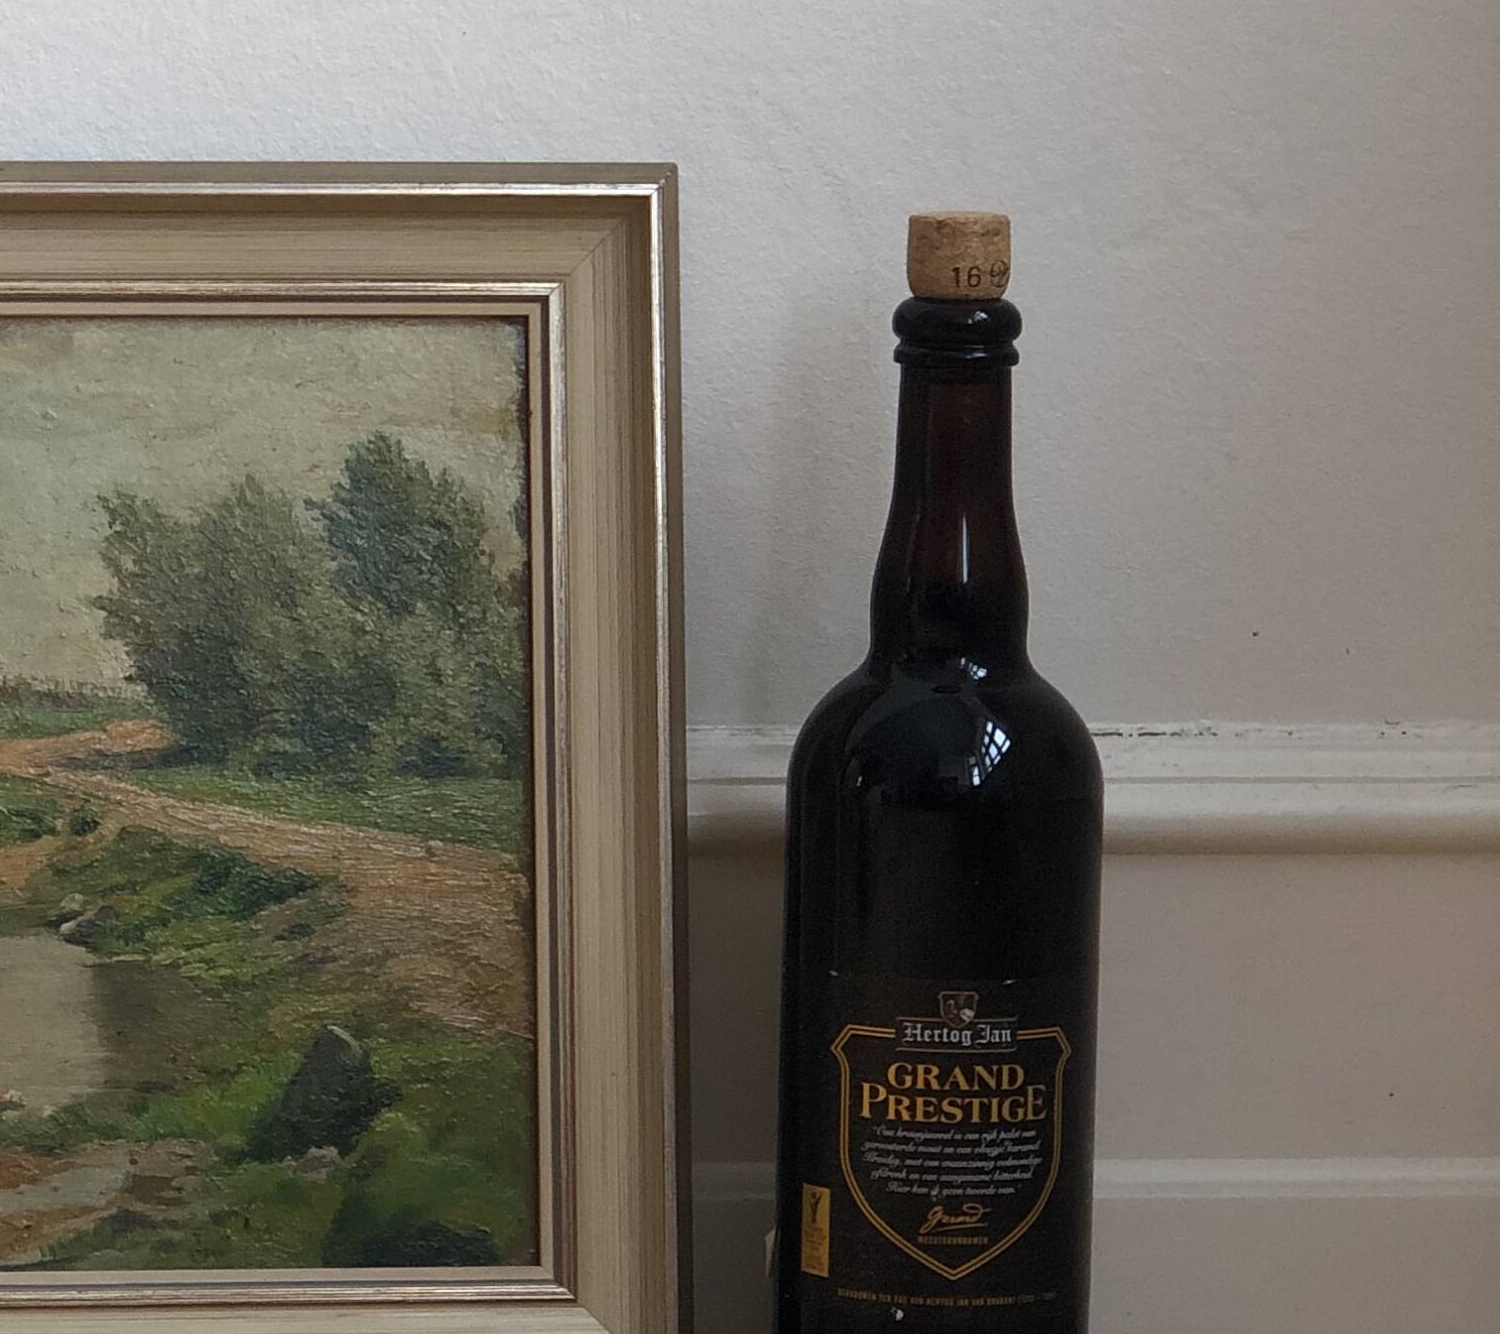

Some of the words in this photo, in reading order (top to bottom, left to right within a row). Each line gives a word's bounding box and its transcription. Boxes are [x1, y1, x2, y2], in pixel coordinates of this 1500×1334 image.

[902, 1022, 973, 1047] Hertog
[975, 1024, 1012, 1045] Jan
[887, 1062, 1026, 1092] GRAND
[860, 1082, 1047, 1124] PRESTIGE
